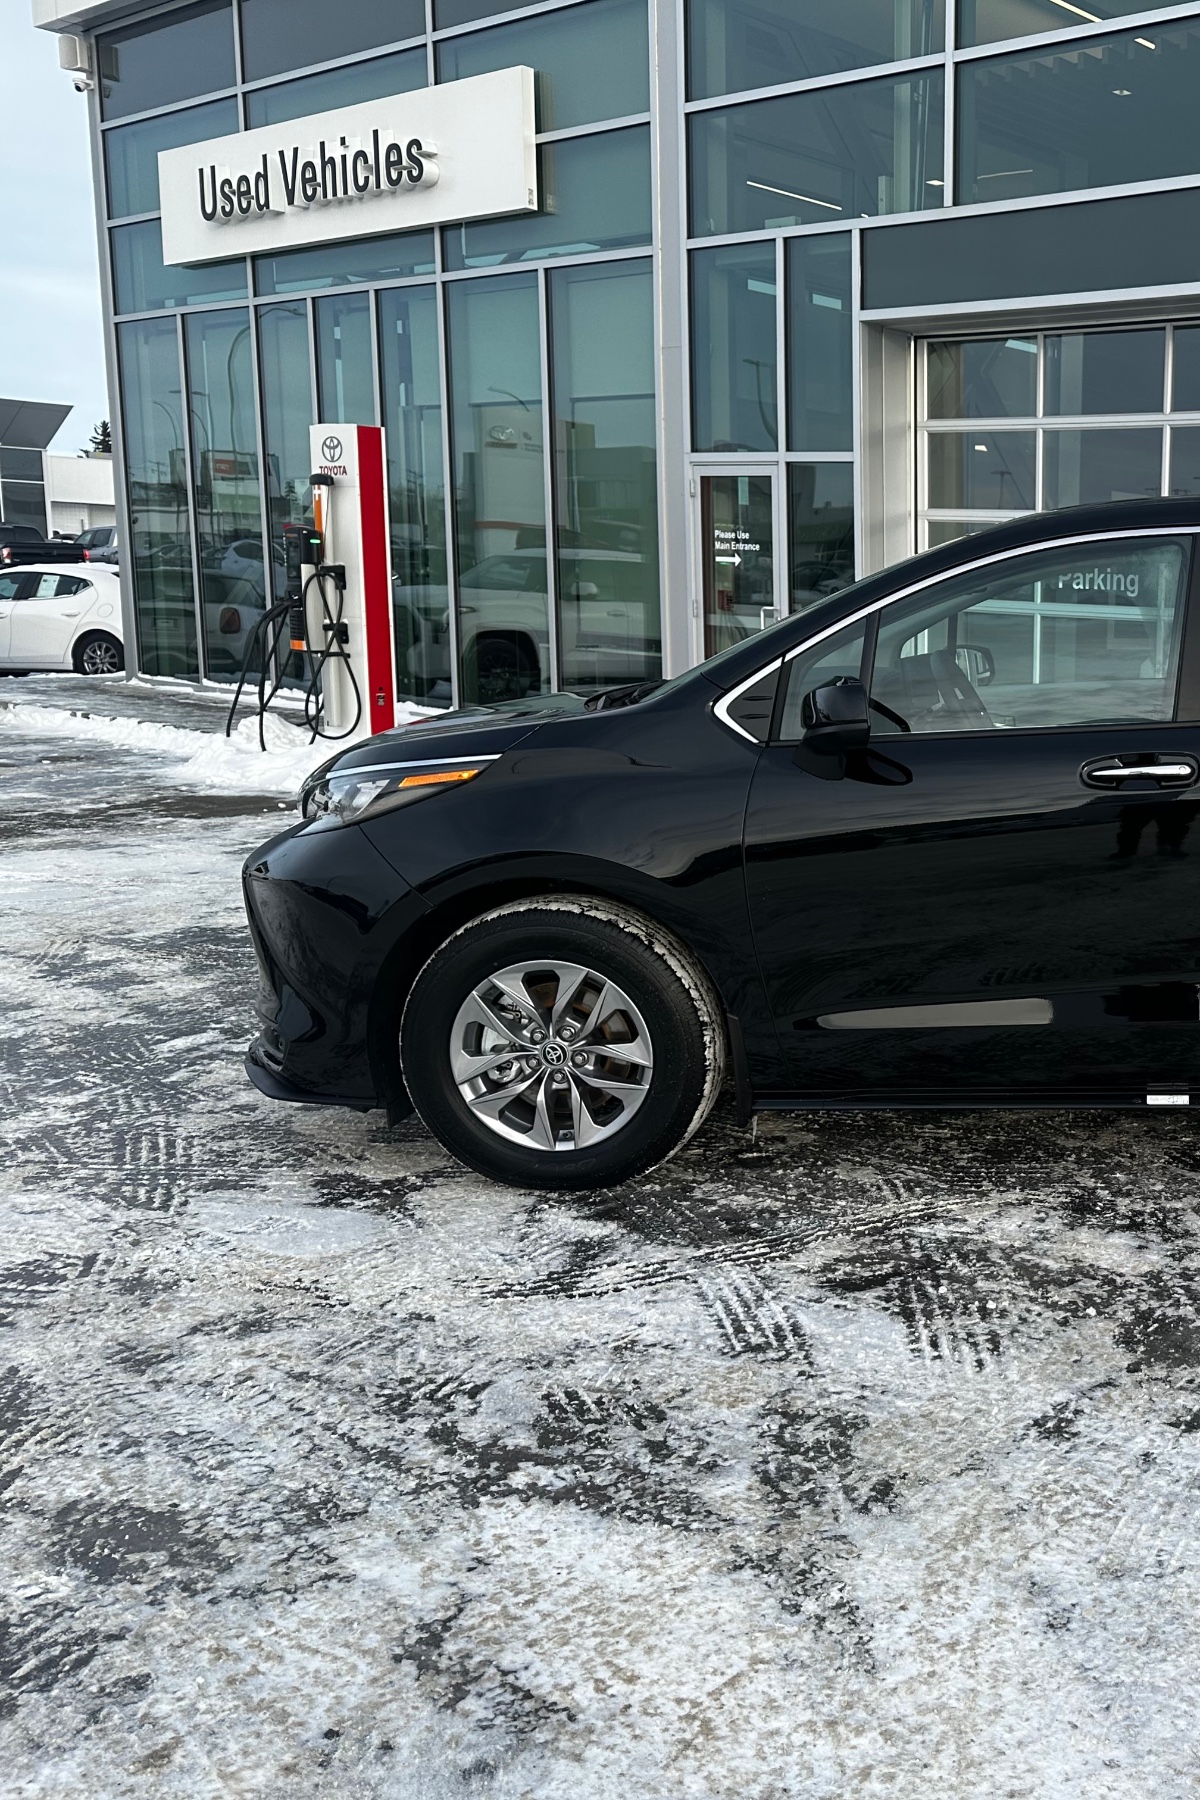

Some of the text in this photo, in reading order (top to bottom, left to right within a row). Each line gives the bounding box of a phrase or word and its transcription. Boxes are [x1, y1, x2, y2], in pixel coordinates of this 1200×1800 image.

[198, 128, 424, 222] Used Vehicles
[319, 465, 347, 476] TOYOTA
[714, 529, 750, 540] Please Use
[714, 541, 760, 552] Main Entrance
